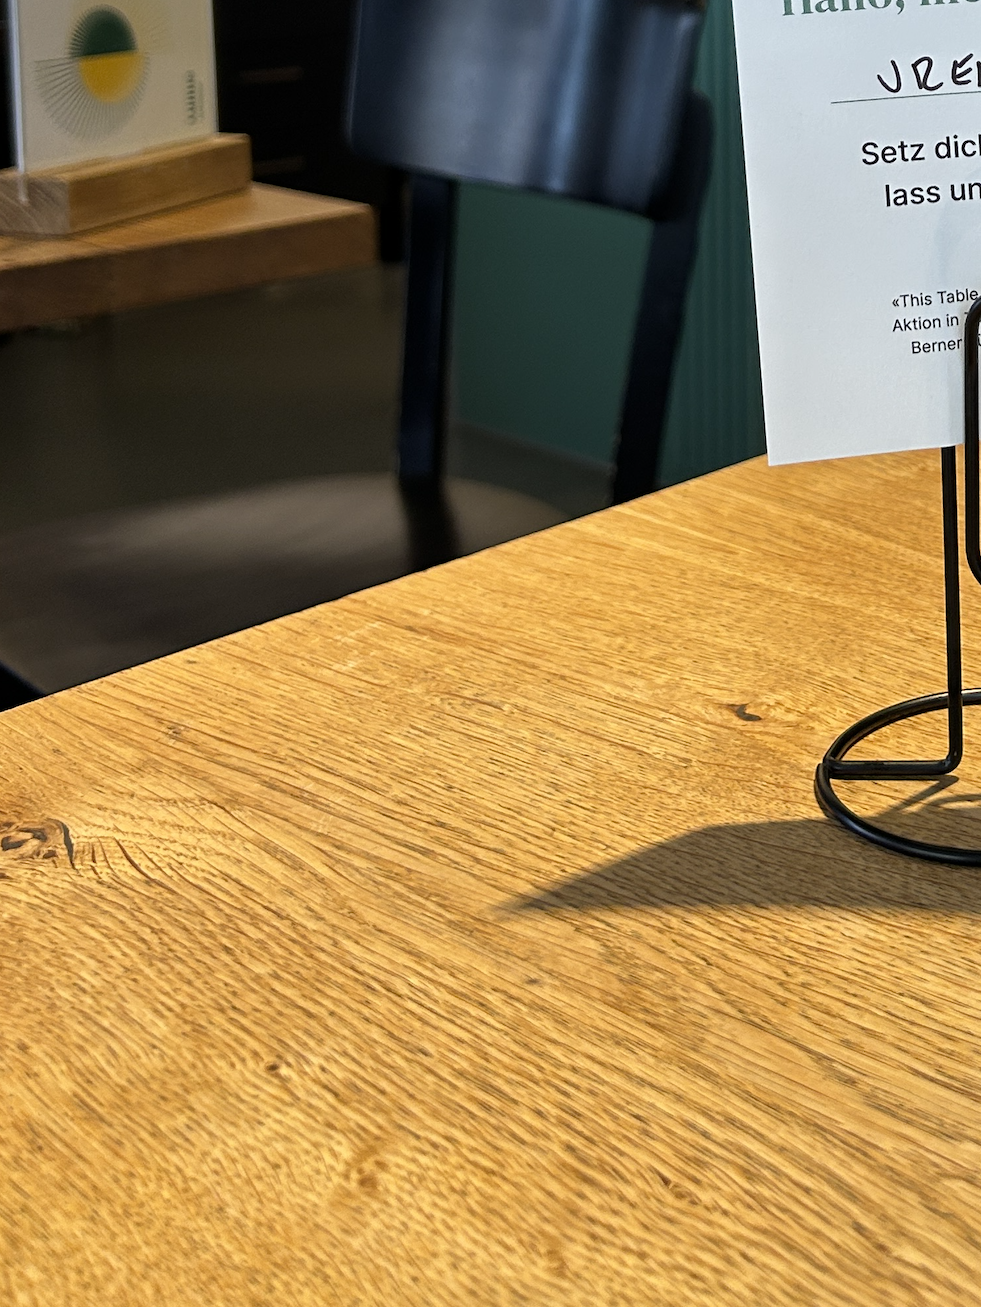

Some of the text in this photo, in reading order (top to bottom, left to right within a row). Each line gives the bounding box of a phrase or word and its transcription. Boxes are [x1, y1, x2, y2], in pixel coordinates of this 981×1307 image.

[861, 141, 925, 165] Setz
[885, 184, 941, 207] lass
[892, 291, 932, 308] «This
[937, 286, 978, 304] Table
[892, 315, 941, 332] Aktion
[946, 313, 959, 327] in
[911, 337, 962, 354] Berner
